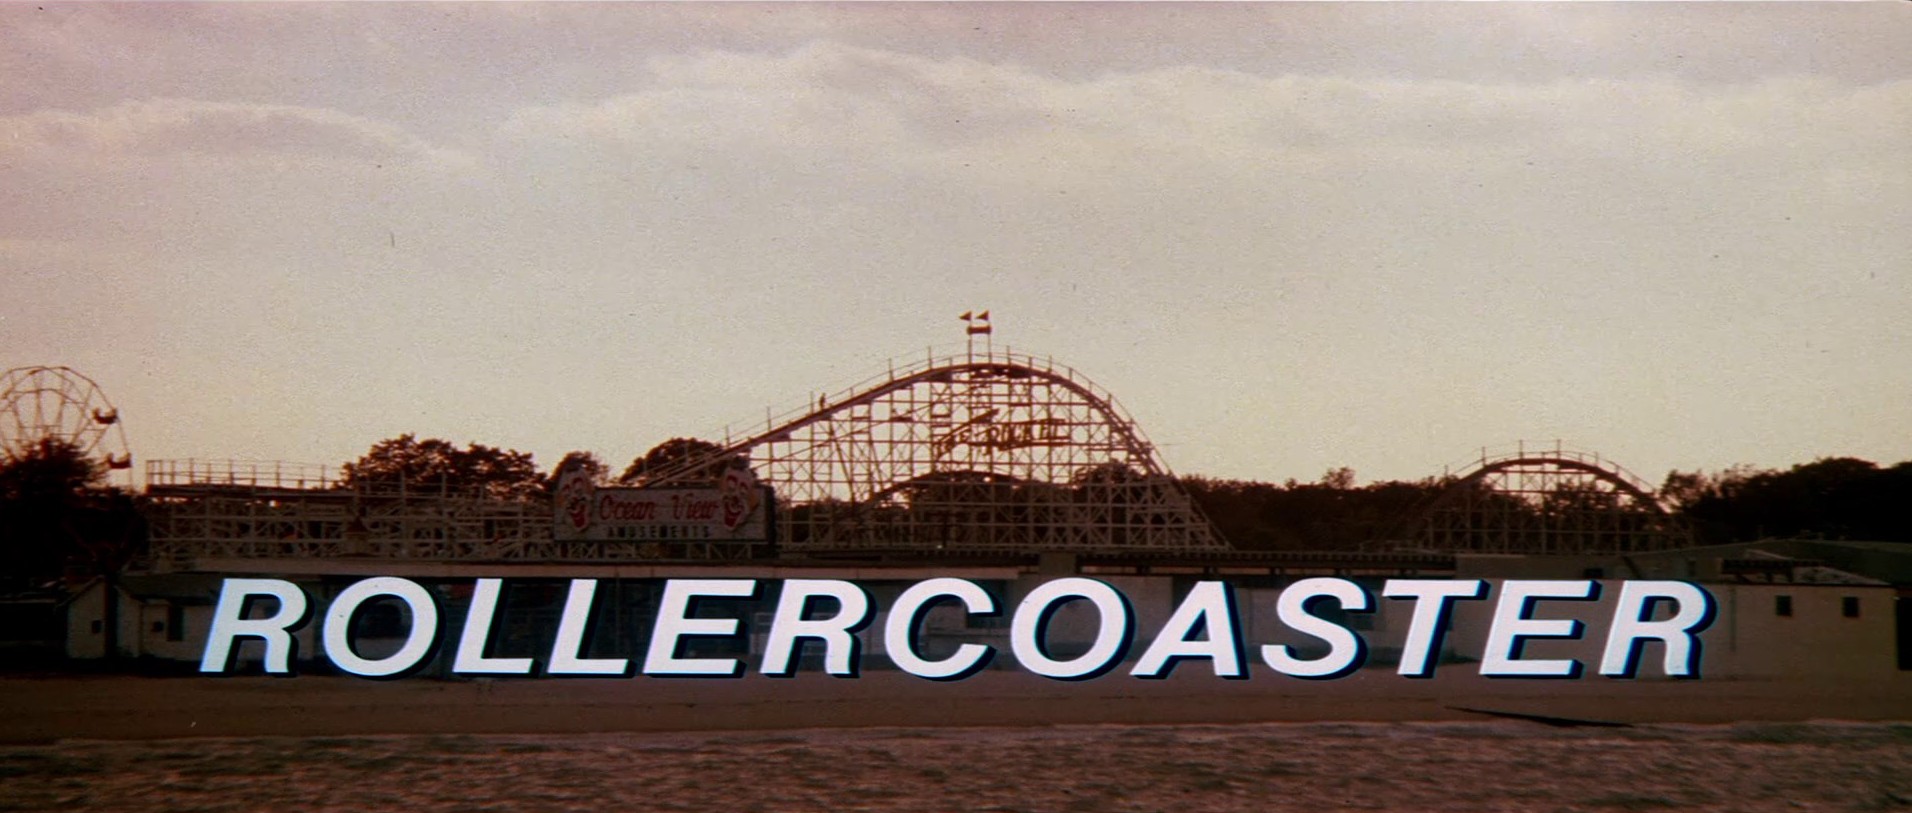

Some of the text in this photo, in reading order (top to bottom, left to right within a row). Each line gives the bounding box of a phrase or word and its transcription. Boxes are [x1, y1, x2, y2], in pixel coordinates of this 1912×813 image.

[599, 493, 718, 521] Ocean View
[607, 525, 710, 538] AMUSEMENTS
